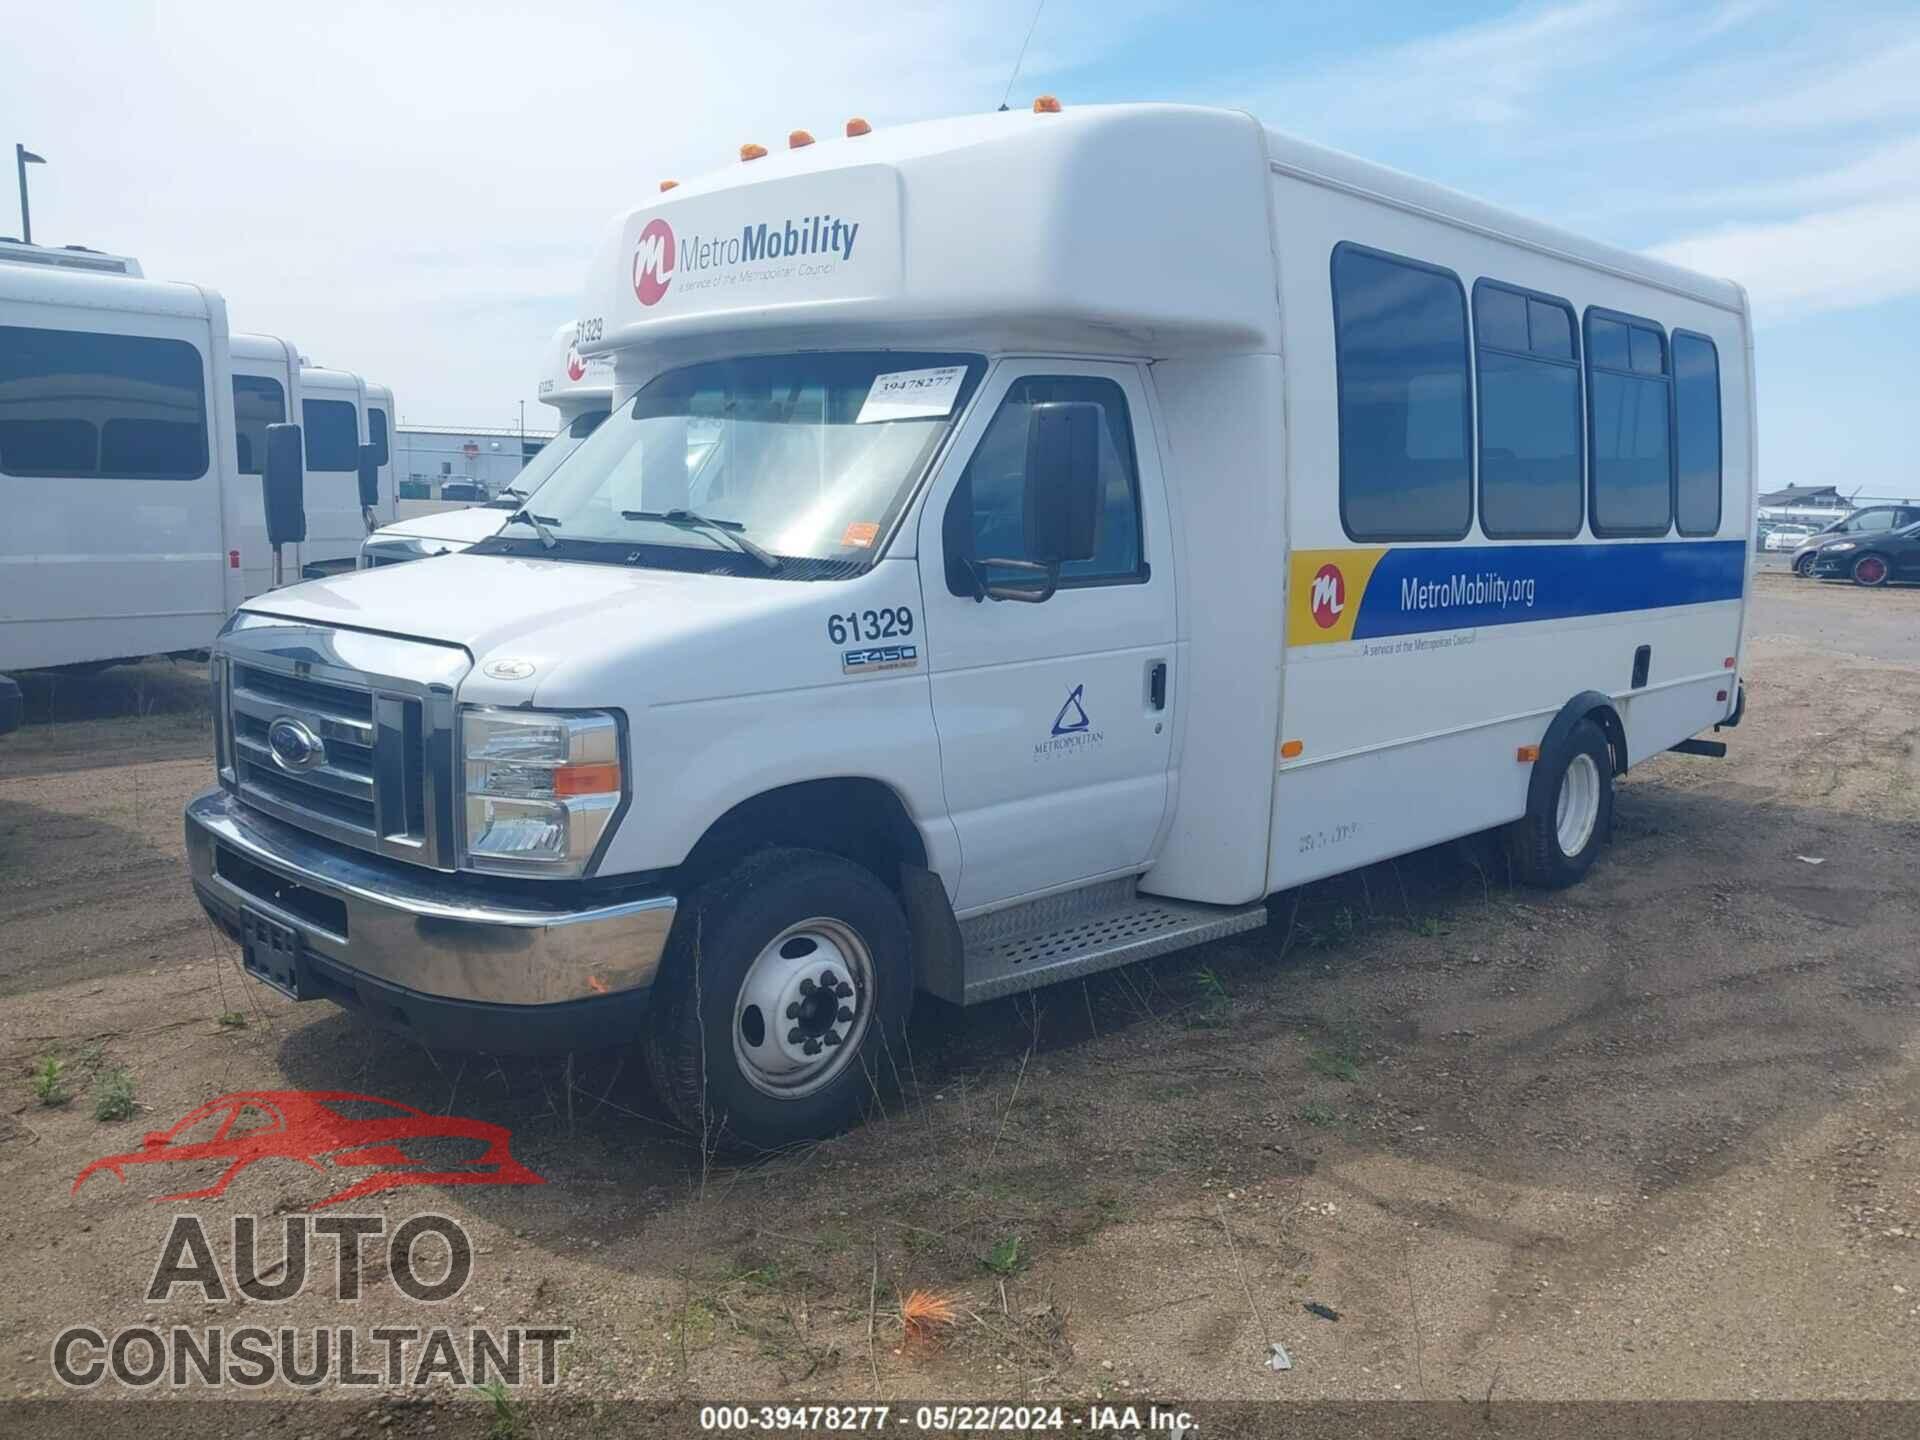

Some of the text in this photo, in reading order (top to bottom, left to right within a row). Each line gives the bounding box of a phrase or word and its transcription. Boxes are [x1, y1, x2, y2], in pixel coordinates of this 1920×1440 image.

[680, 215, 859, 273] MetroMobility
[799, 263, 835, 277] Council
[1401, 573, 1535, 611] MetroMobility.org
[828, 606, 914, 645] 61329
[1370, 645, 1393, 656] service
[1414, 635, 1452, 651] Metropolitan
[1034, 730, 1104, 753] METROPOLITAN
